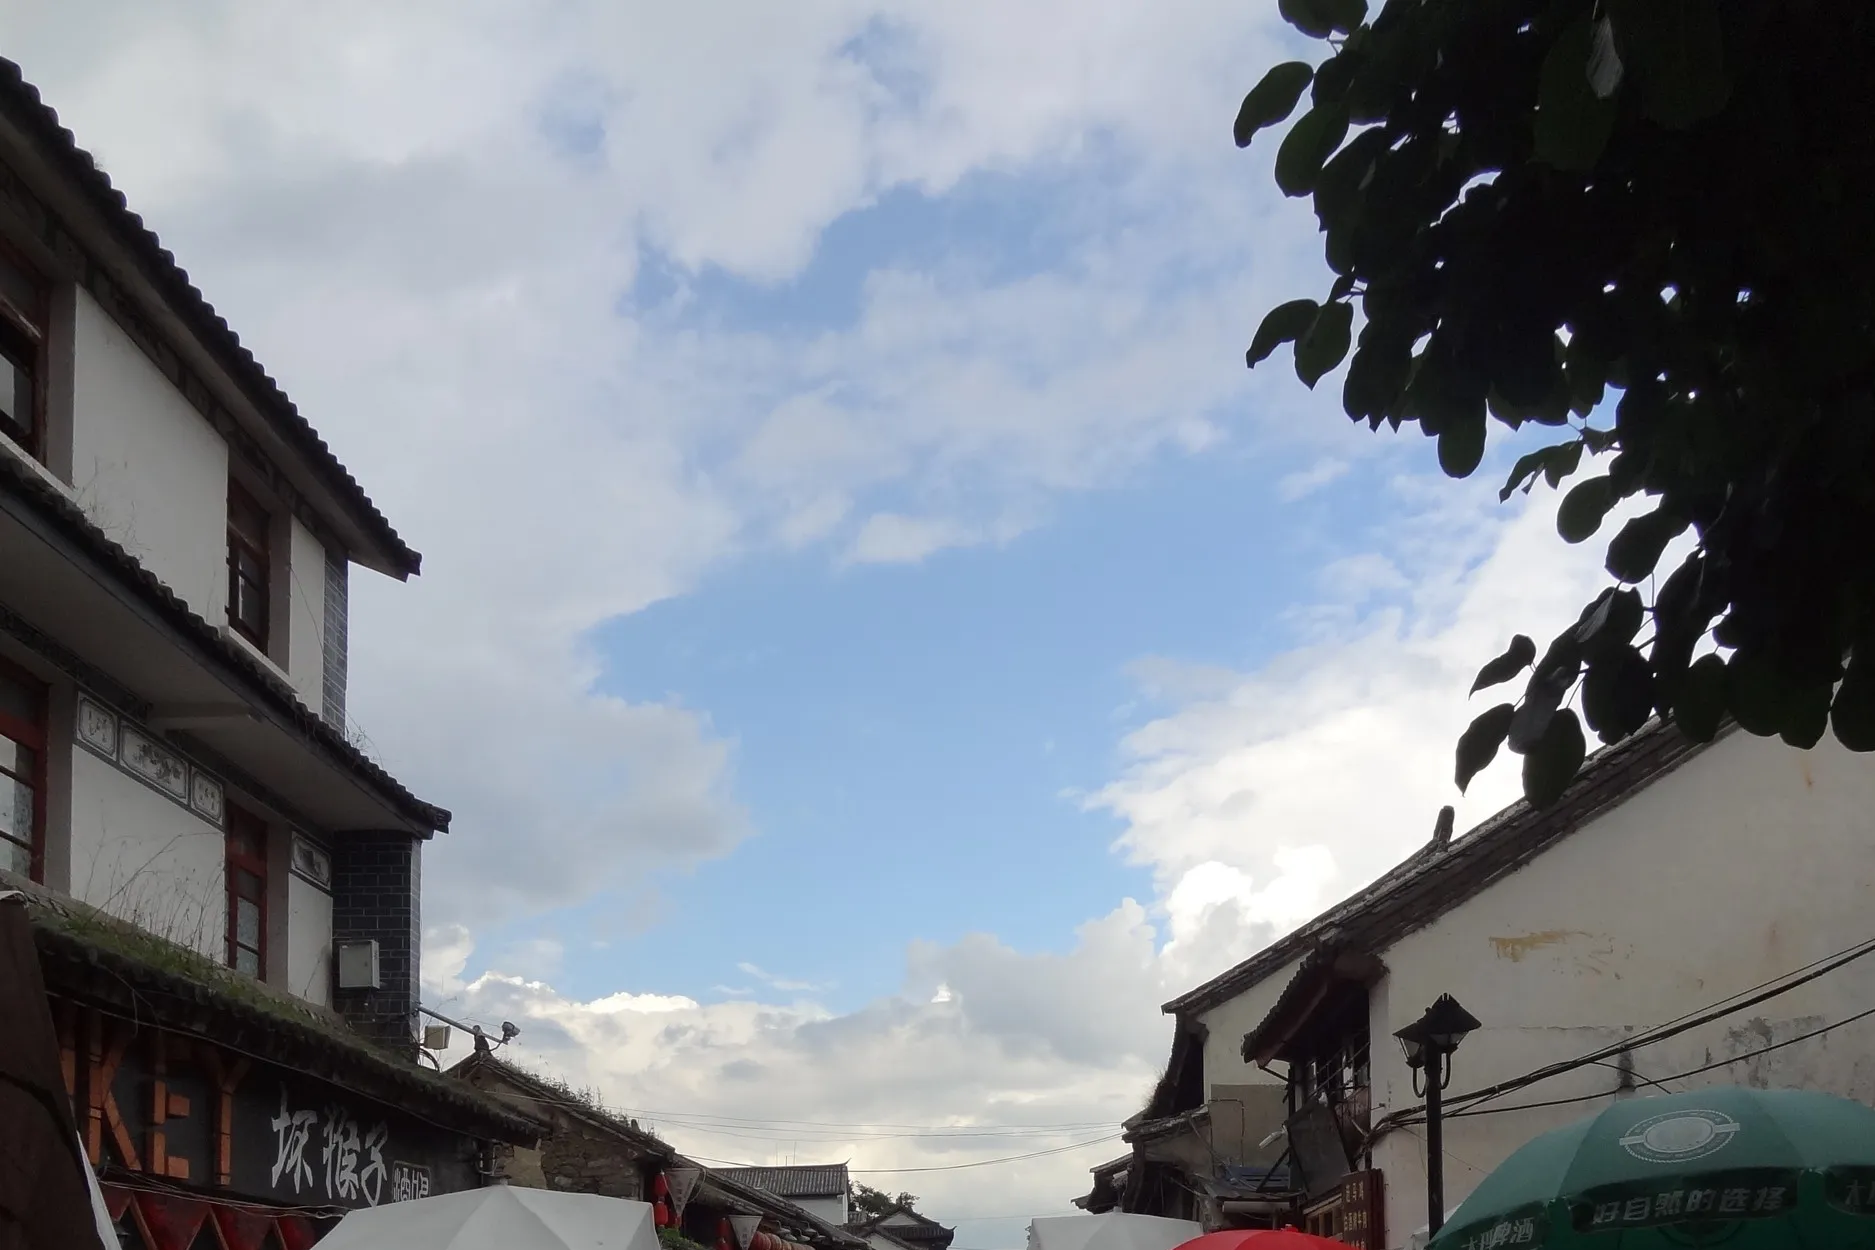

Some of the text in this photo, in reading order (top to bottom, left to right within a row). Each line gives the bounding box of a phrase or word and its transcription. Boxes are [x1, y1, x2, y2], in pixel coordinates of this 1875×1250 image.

[1592, 1187, 1787, 1225] 好自然的选择
